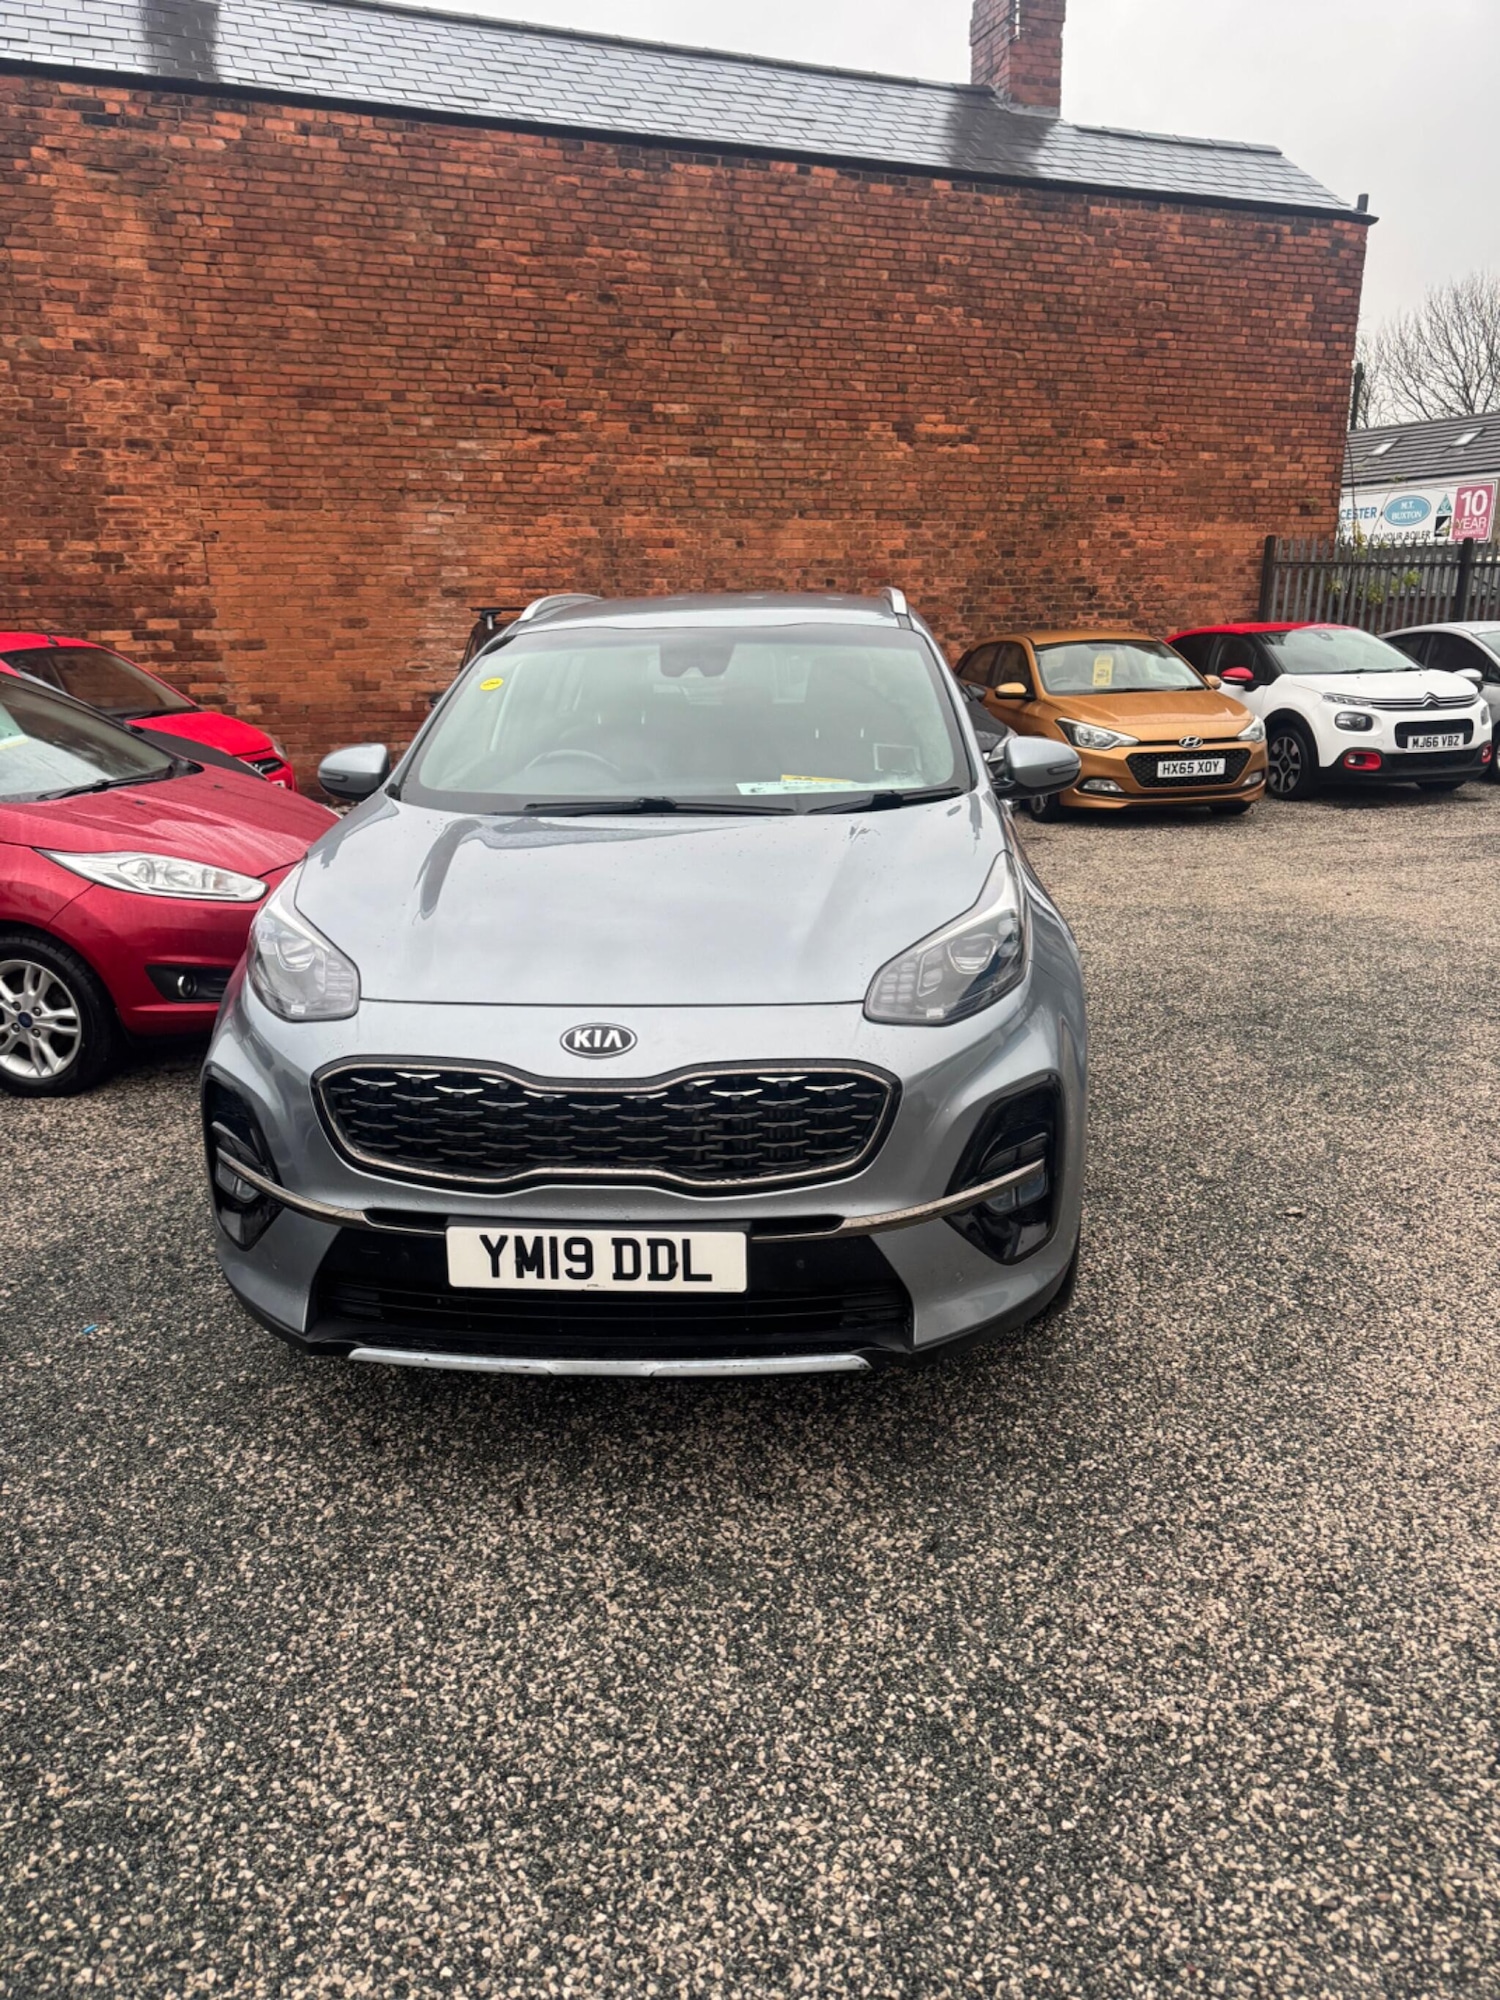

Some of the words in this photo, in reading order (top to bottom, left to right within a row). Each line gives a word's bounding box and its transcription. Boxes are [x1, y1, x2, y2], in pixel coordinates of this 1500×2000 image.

[1460, 489, 1488, 517] 10
[1391, 510, 1422, 520] BUXTON
[1456, 516, 1487, 529] YEAR
[1383, 531, 1402, 540] YOUR
[1404, 530, 1431, 540] BOILER
[1412, 736, 1438, 748] MJ66
[1442, 735, 1460, 746] VBZ
[1163, 762, 1194, 775] HX65
[1197, 761, 1220, 773] XOY
[573, 1029, 623, 1048] KIA
[479, 1234, 594, 1280] YM19
[611, 1237, 713, 1282] DDL
